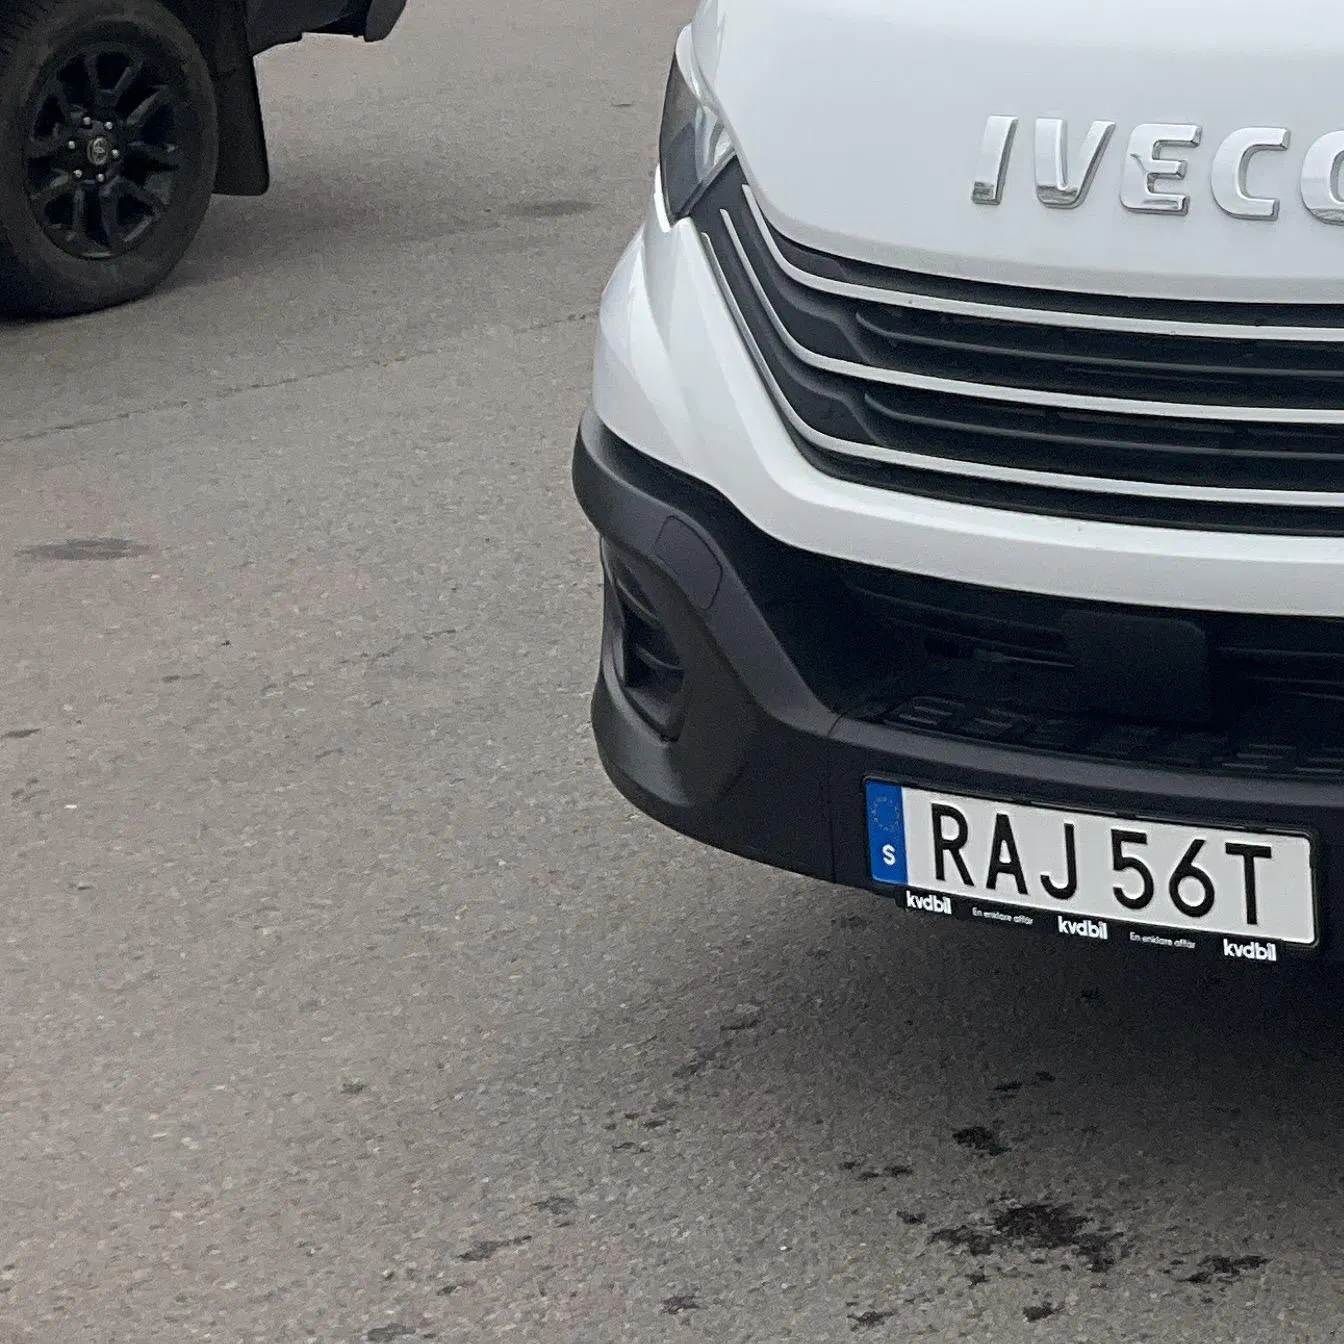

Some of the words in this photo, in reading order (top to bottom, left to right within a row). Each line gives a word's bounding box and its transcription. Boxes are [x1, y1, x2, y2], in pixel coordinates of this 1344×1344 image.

[882, 844, 896, 866] S
[931, 803, 1077, 900] RAJ
[1110, 828, 1272, 925] 56T
[906, 890, 952, 915] kvdbil
[1057, 916, 1108, 940] kvdbil
[1223, 939, 1277, 962] kvdbil
